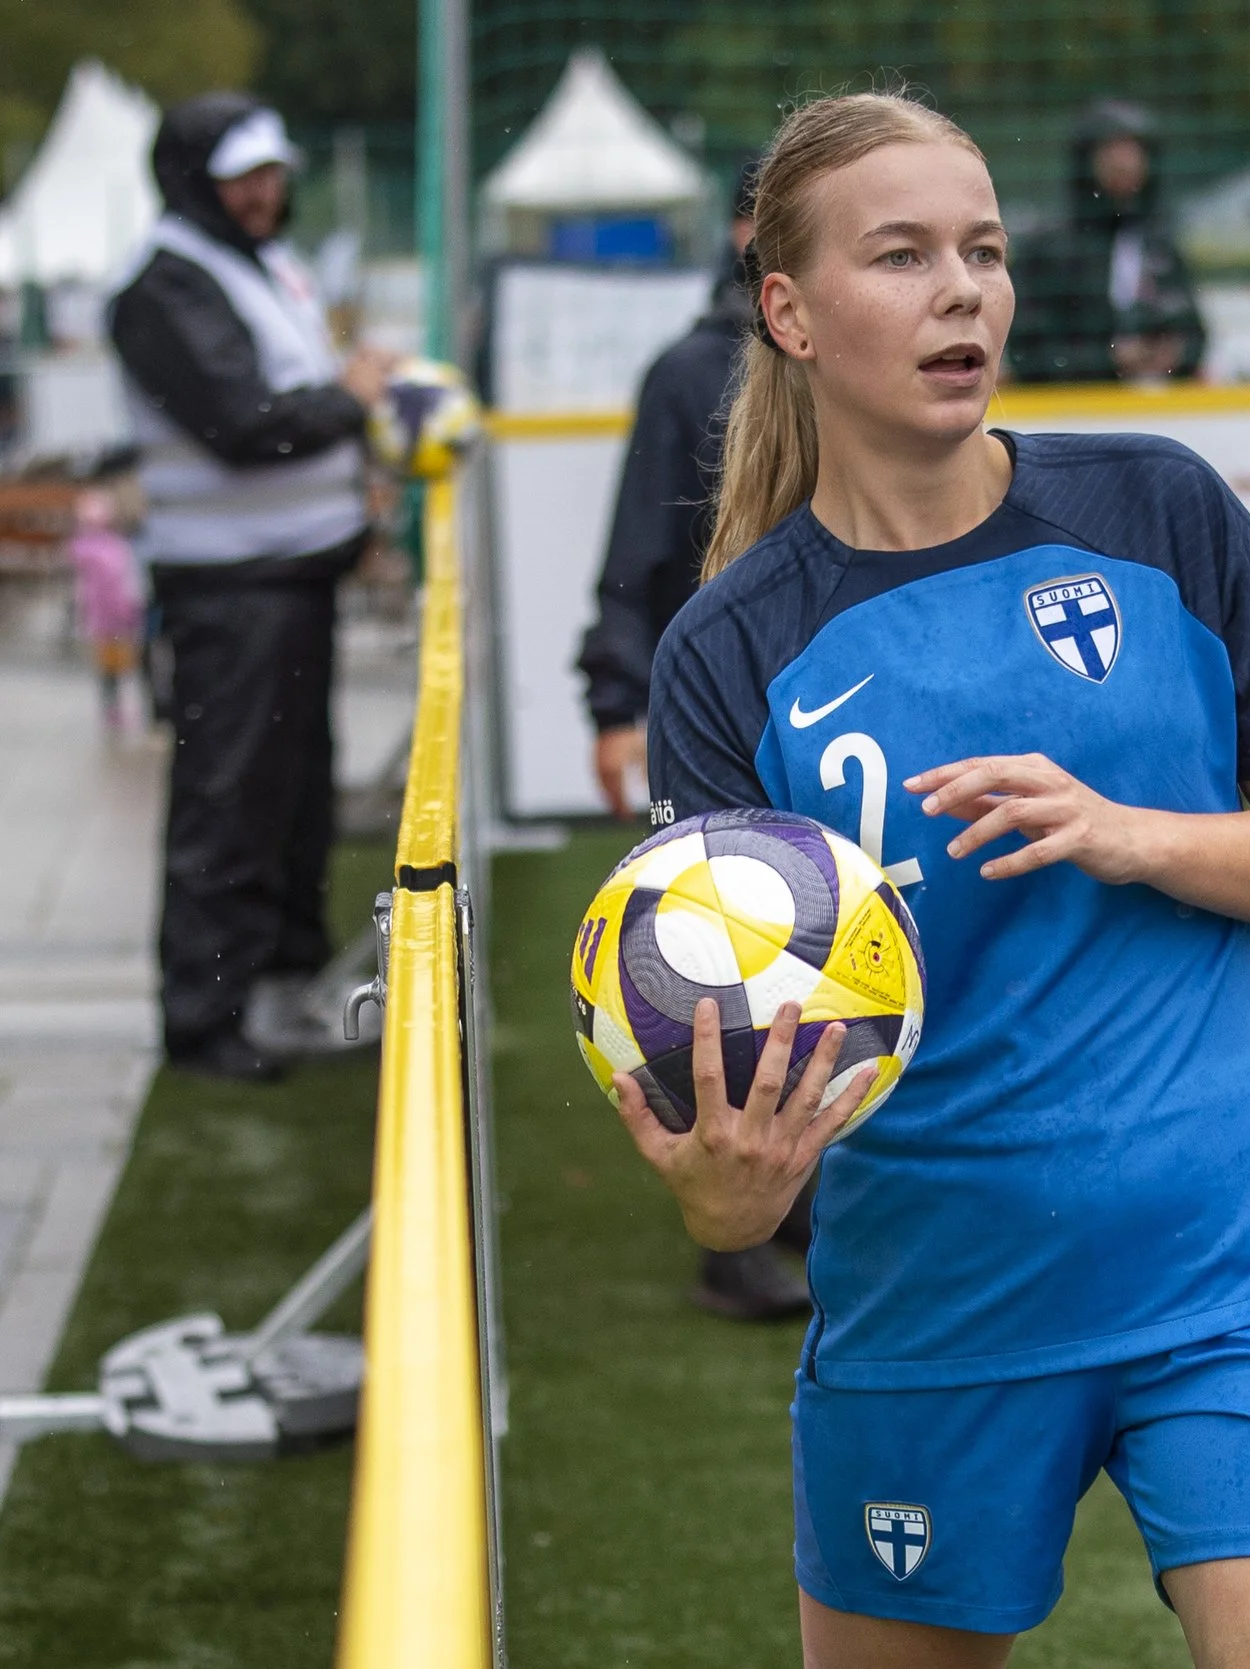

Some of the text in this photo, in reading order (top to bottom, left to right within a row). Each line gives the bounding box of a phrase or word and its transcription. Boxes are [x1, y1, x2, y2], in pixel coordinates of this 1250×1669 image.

[1036, 583, 1095, 606] SUOMI
[820, 732, 924, 888] 2
[875, 1510, 919, 1521] SUOMI
